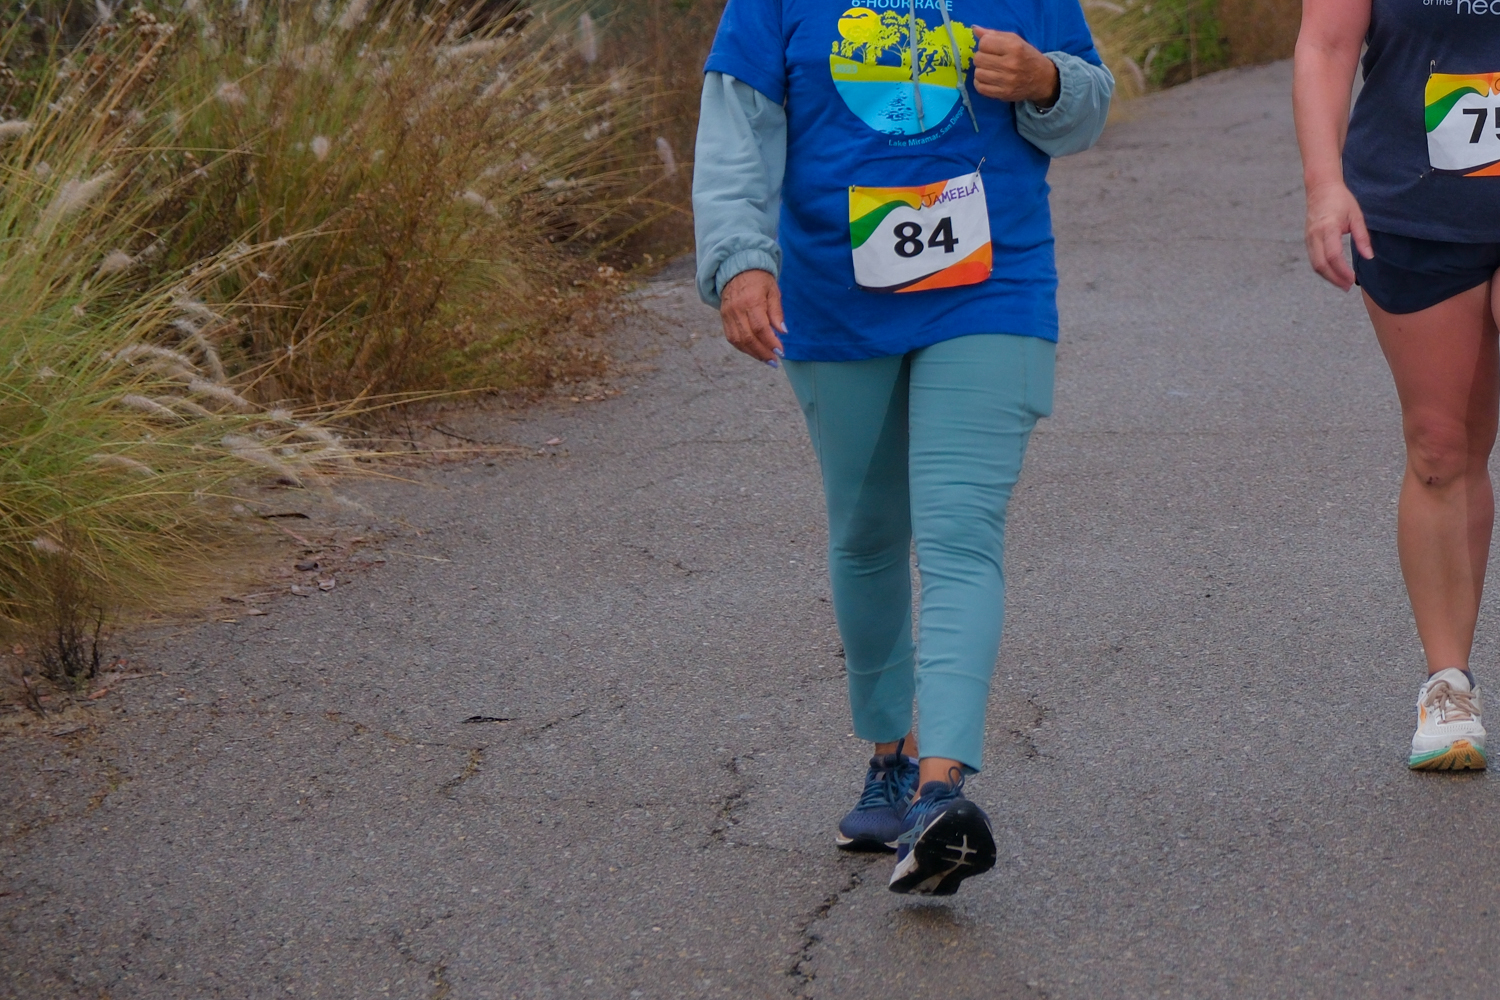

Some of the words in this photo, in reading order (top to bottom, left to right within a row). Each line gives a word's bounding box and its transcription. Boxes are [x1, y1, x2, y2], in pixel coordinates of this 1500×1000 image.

[888, 139, 907, 147] Lake
[908, 133, 941, 147] Miramar,
[940, 124, 952, 136] San
[949, 106, 965, 126] Diego
[921, 182, 980, 208] JAMEELA
[893, 216, 959, 258] 84
